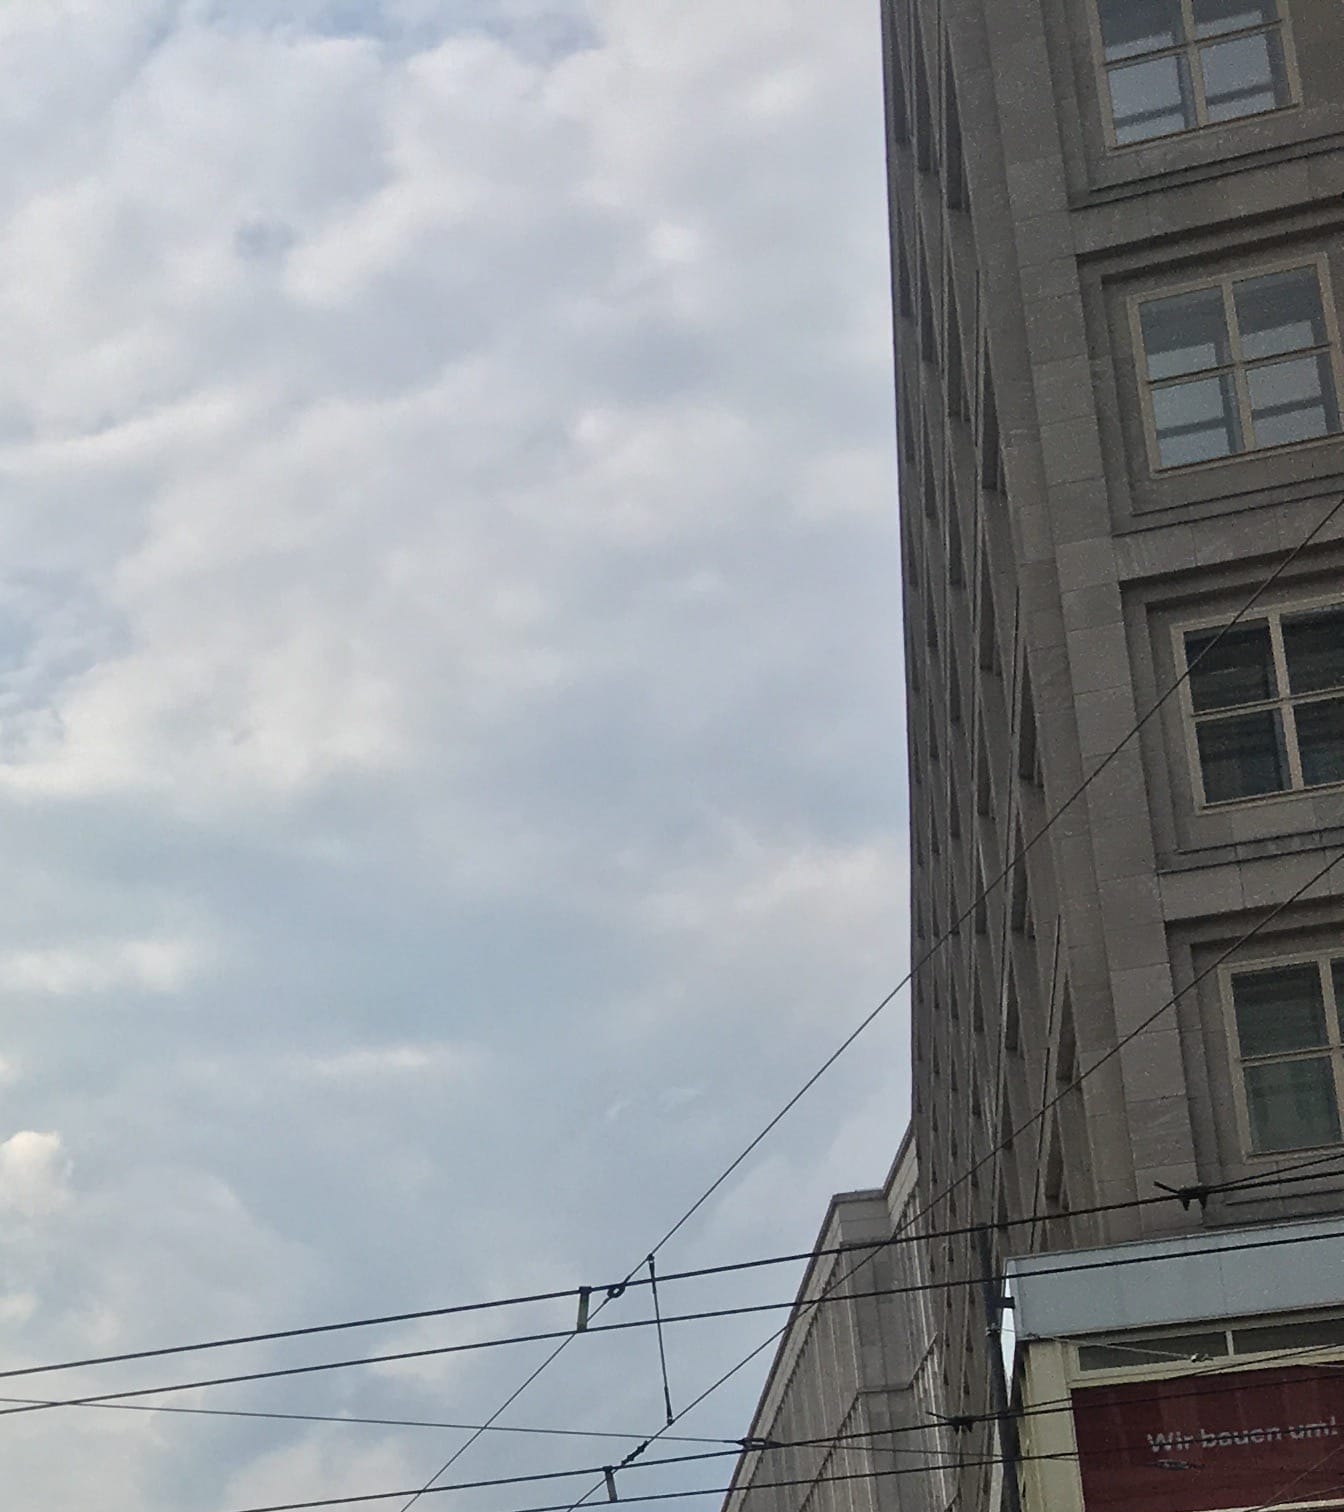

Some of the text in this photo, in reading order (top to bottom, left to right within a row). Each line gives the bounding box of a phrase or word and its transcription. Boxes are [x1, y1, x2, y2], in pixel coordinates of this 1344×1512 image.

[1147, 1415, 1339, 1452] Wir bauen um!
